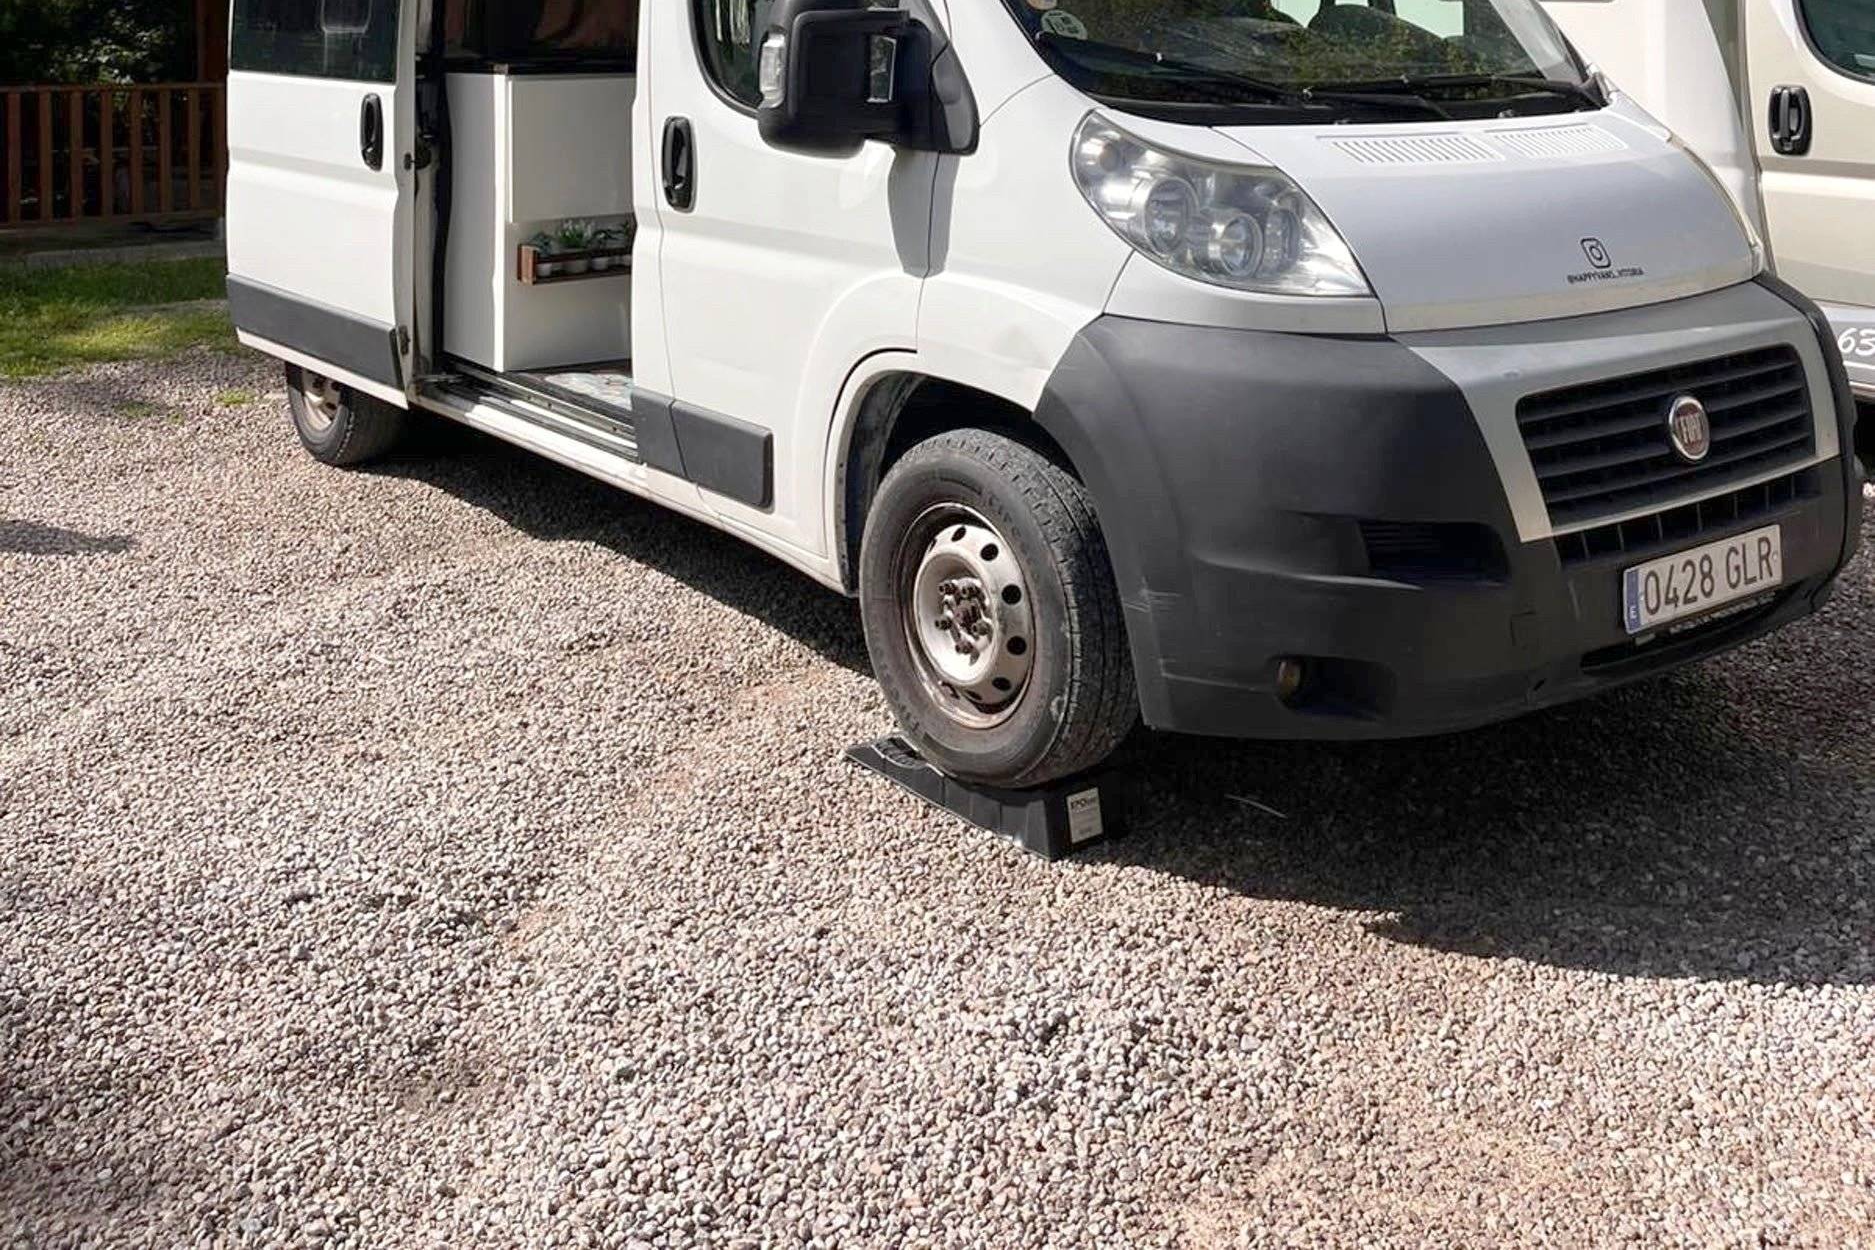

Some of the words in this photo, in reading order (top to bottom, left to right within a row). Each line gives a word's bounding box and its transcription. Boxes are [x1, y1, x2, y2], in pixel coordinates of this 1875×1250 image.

[1675, 412, 1703, 445] FIAT
[1644, 553, 1715, 615] 0428
[1726, 536, 1774, 590] GLR
[1629, 605, 1638, 619] E
